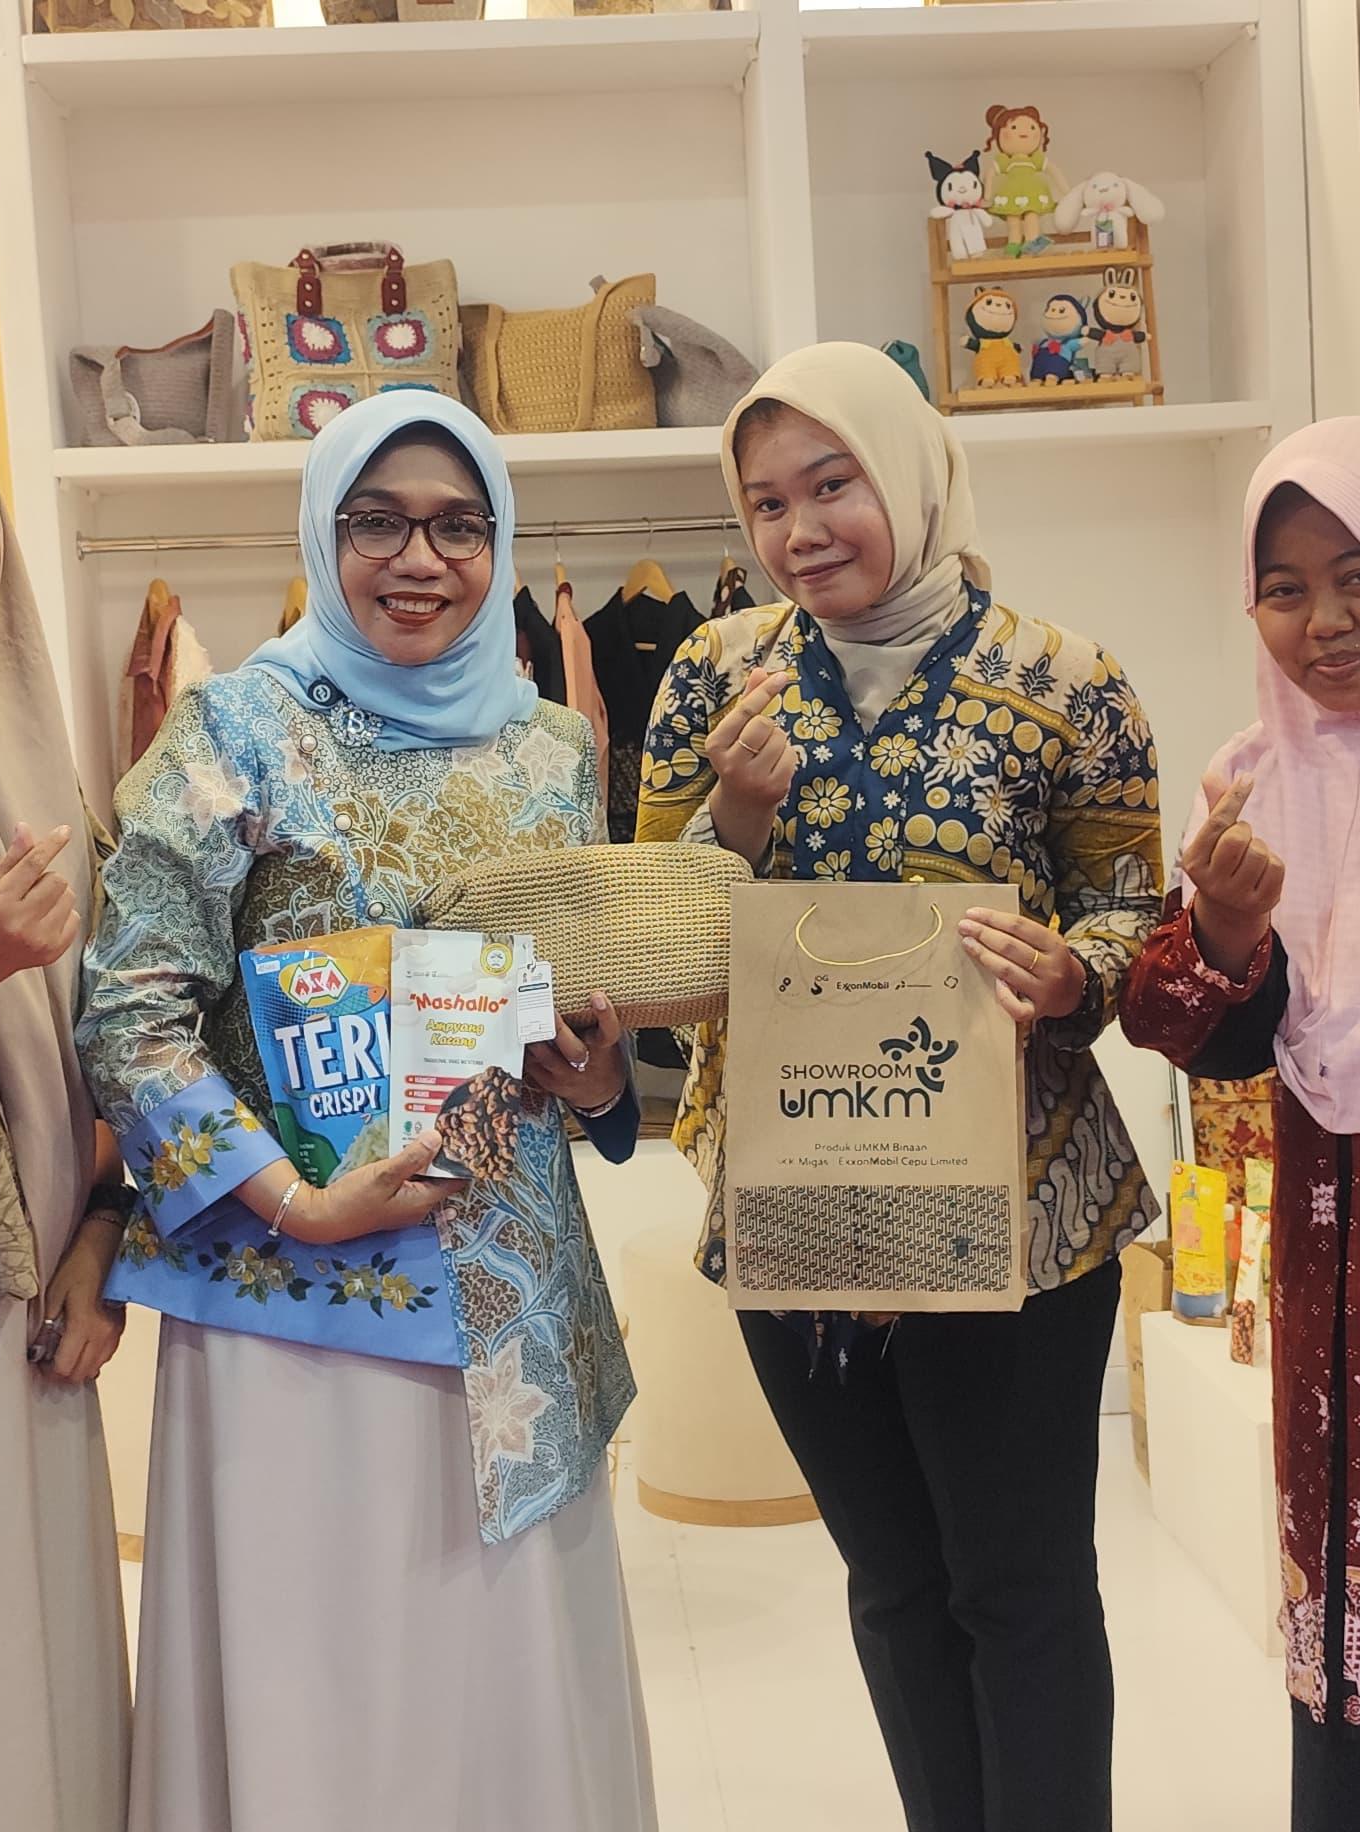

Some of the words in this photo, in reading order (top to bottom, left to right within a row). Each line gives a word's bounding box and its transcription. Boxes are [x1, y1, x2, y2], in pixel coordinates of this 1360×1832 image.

[836, 981, 890, 993] ExxonMobil
[425, 1018, 485, 1037] Ampyang
[430, 1032, 477, 1050] Kacang
[274, 1011, 390, 1090] TERI
[780, 1063, 912, 1080] SHOWROOM
[309, 1083, 380, 1119] CRISPY
[814, 1142, 851, 1152] Produk
[854, 1142, 890, 1152] UMKM
[892, 1142, 928, 1152] Binaan
[798, 1157, 829, 1168] Migas
[838, 1156, 899, 1166] ExxonMobil
[900, 1156, 928, 1167] Cepu
[930, 1156, 968, 1166] Limited
